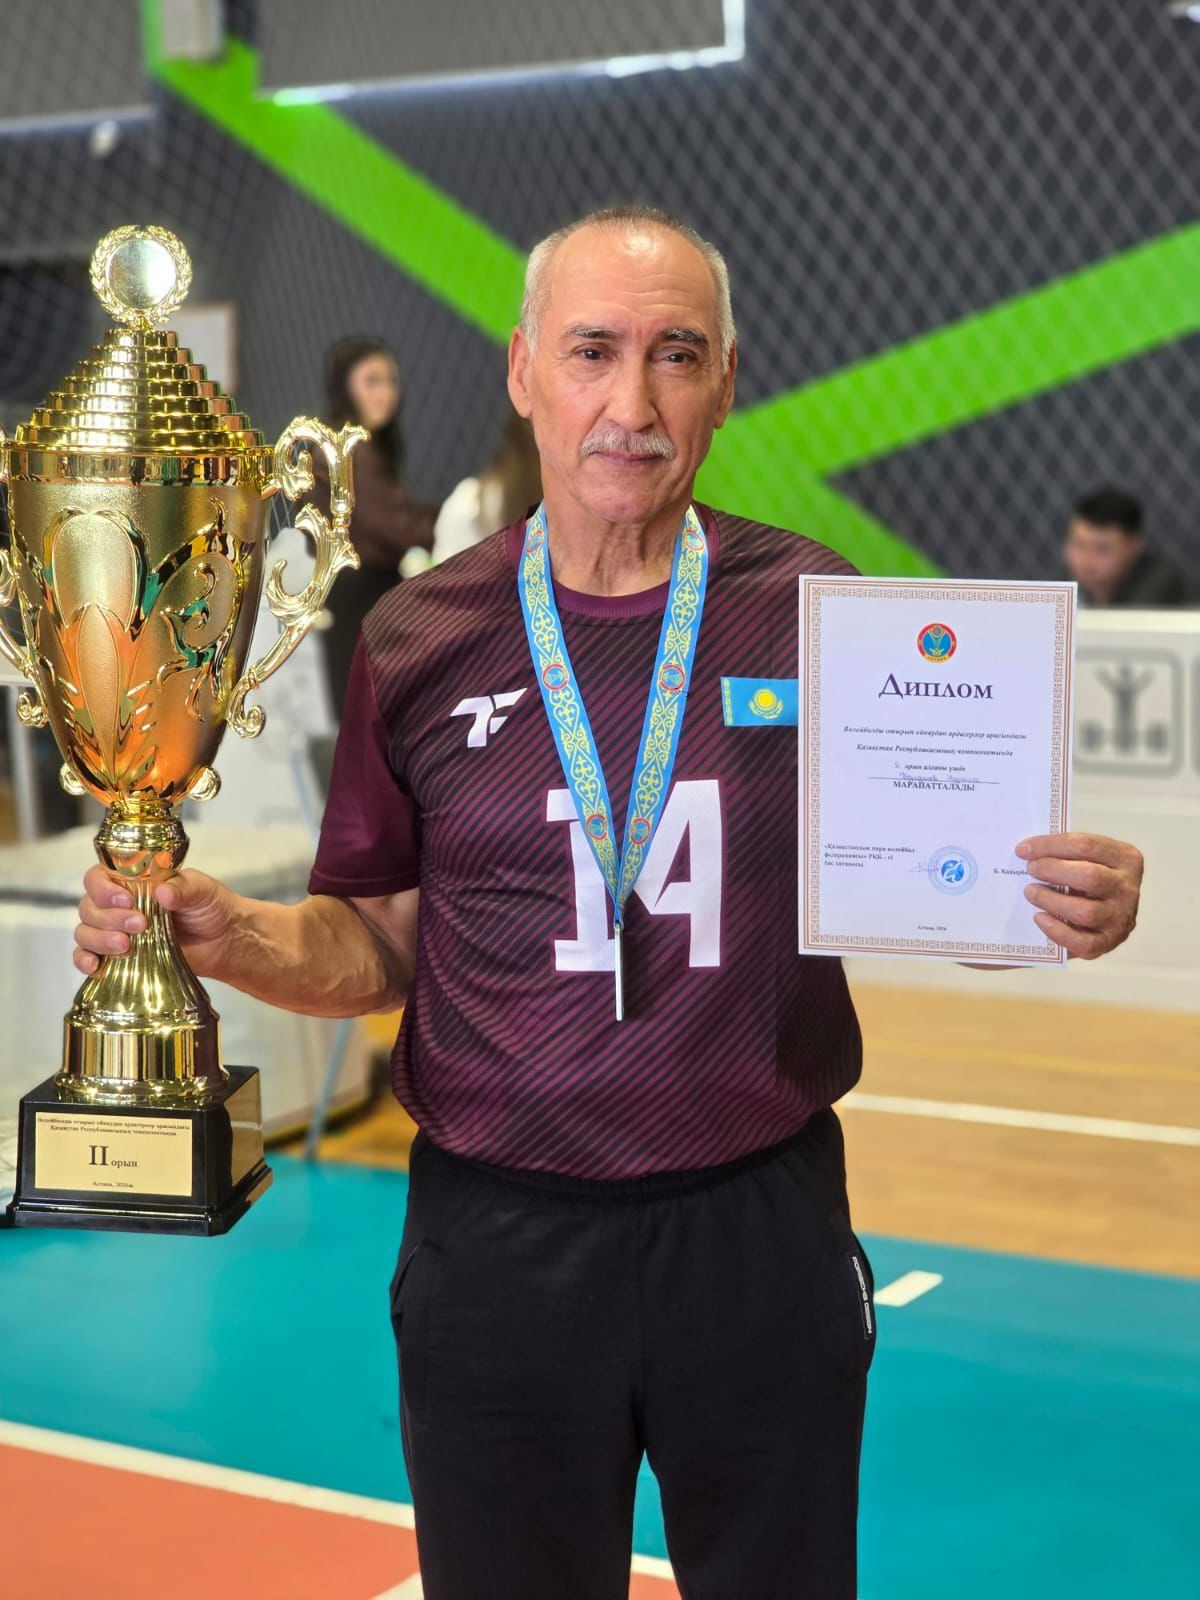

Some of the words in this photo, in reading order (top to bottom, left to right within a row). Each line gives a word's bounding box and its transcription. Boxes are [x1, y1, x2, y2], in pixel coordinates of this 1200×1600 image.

[878, 672, 993, 700] Диплом
[893, 780, 975, 792] МАРАПАТТАЛАДЫ
[546, 779, 723, 972] 14
[110, 1160, 138, 1169] орын
